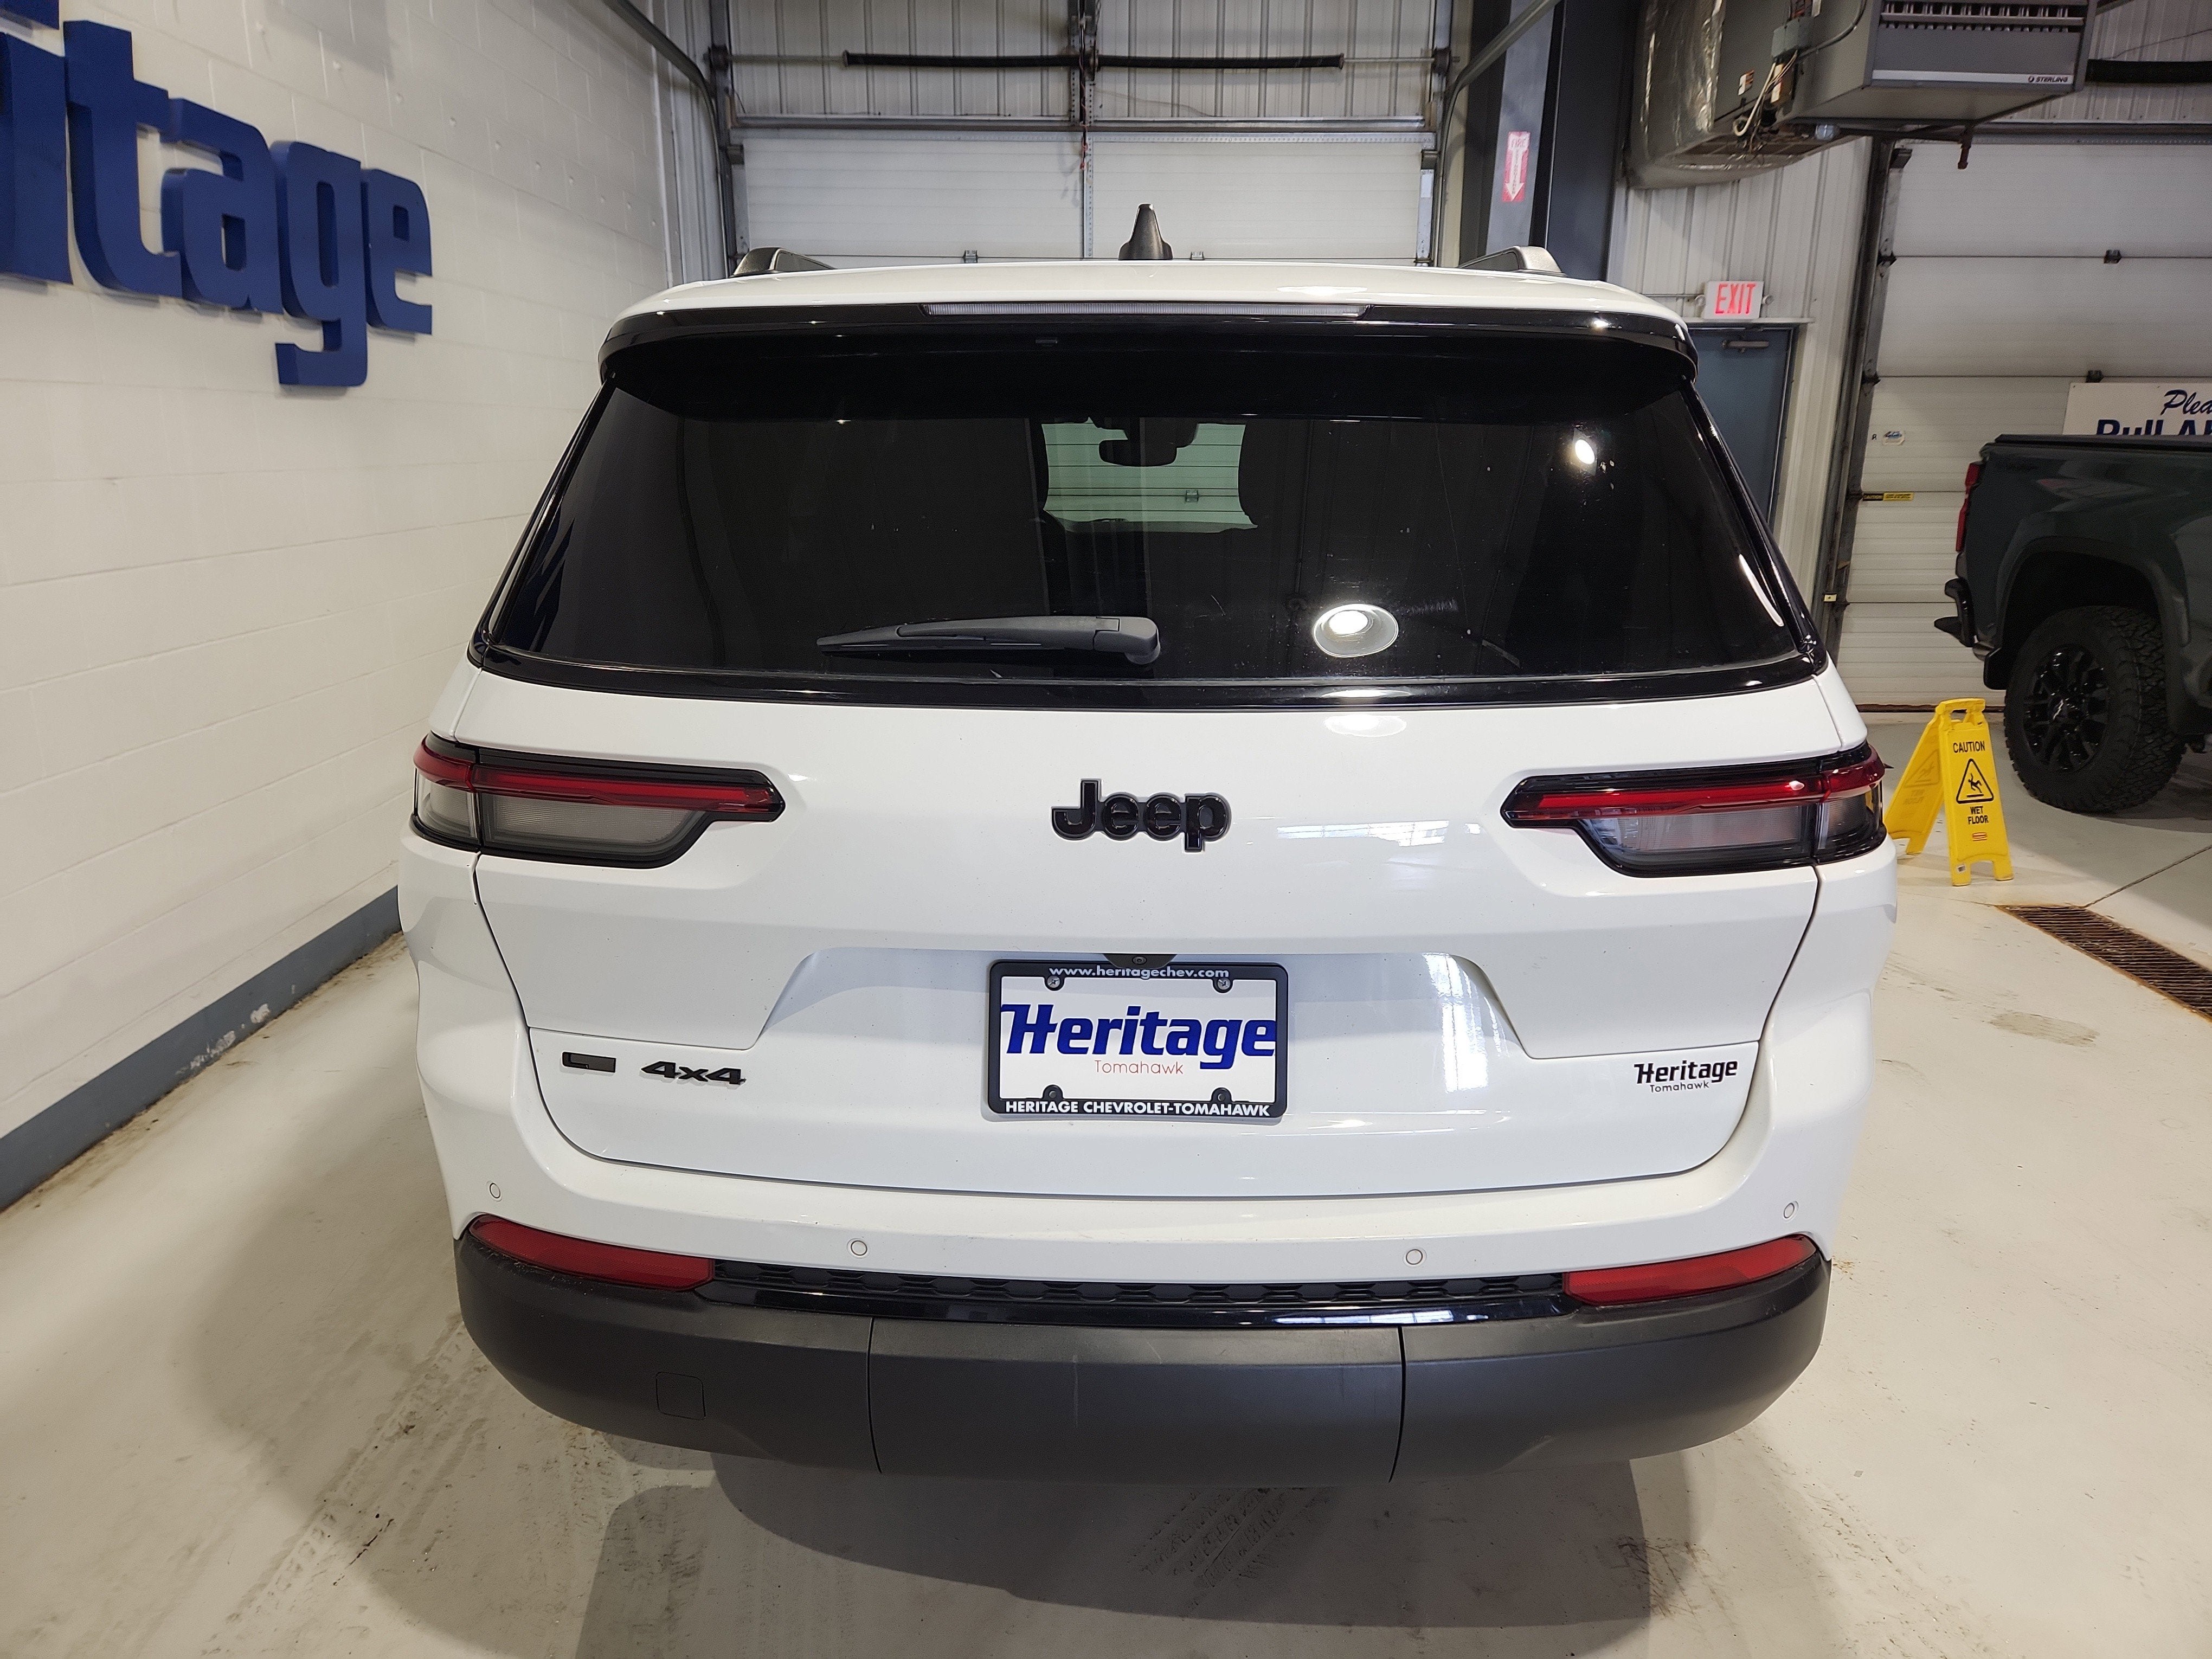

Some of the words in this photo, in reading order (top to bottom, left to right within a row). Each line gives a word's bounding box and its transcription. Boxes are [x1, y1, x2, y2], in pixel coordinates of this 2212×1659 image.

[1715, 284, 1756, 314] EXIT
[1953, 741, 1985, 754] CAUTION
[1051, 779, 1231, 852] Jeep
[1970, 806, 1984, 814] WET
[1967, 815, 1989, 825] FLOOR
[1049, 965, 1229, 980] www.heritagechev.com
[1001, 1004, 1276, 1070] Heritage
[641, 1061, 746, 1085] 4x4
[1095, 1060, 1184, 1075] Tomahawk
[1634, 1060, 1738, 1083] Heritage
[1650, 1081, 1709, 1093] Tomahawk
[1006, 1101, 1078, 1114] HERITAGE
